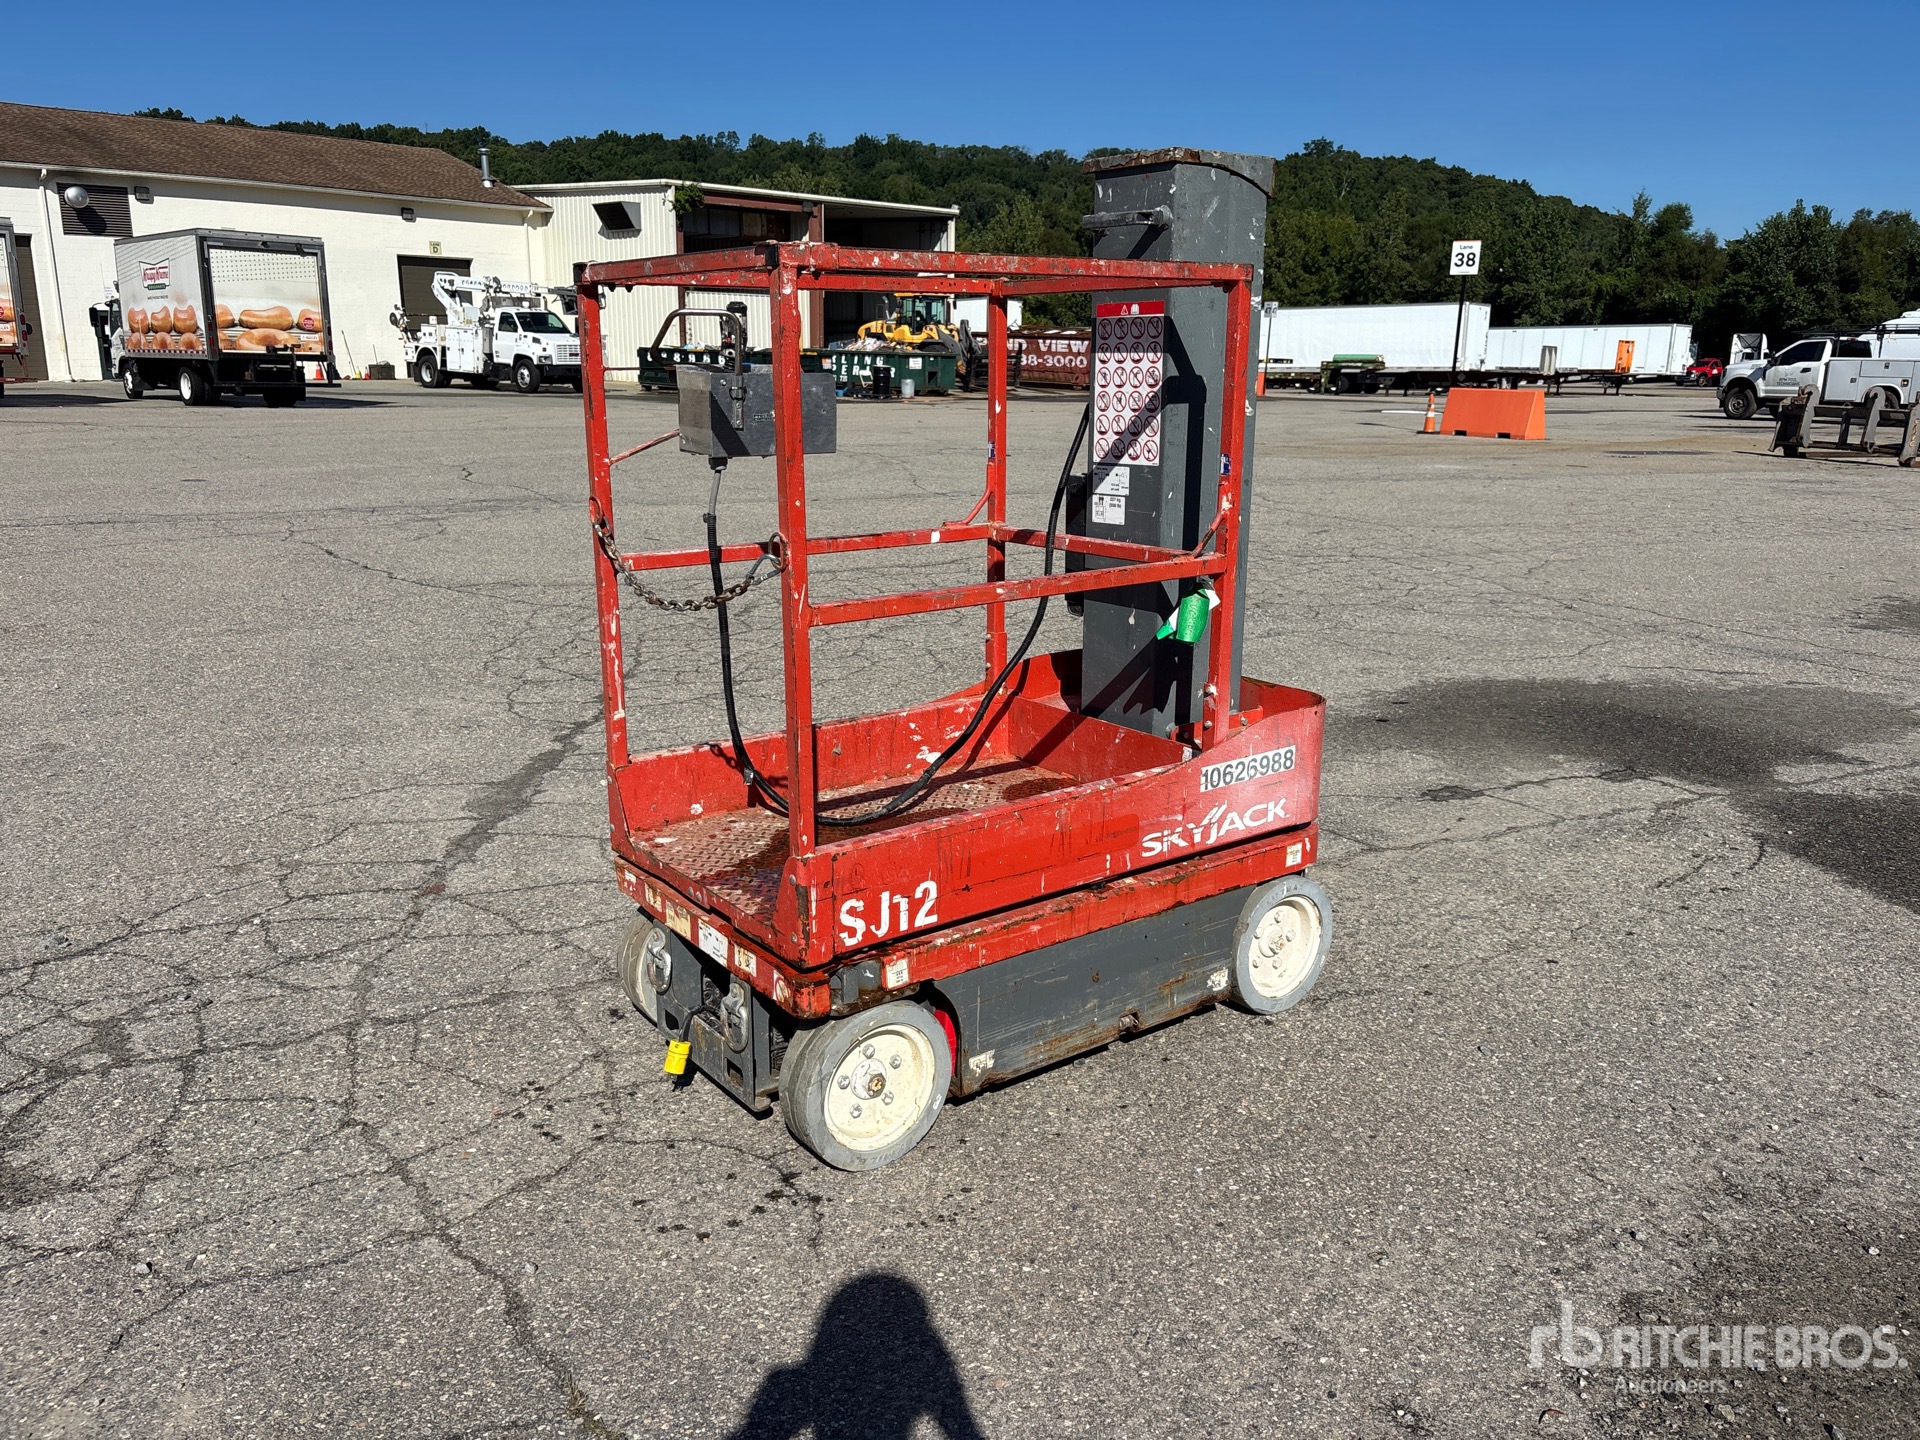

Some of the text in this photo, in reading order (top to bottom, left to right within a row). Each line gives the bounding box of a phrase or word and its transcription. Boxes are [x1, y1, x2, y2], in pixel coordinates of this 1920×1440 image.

[1454, 252, 1476, 267] 38
[1037, 338, 1089, 353] VIEW
[1201, 748, 1294, 791] 10626988
[1141, 798, 1288, 857] SKYJACK
[839, 880, 938, 947] SJ12
